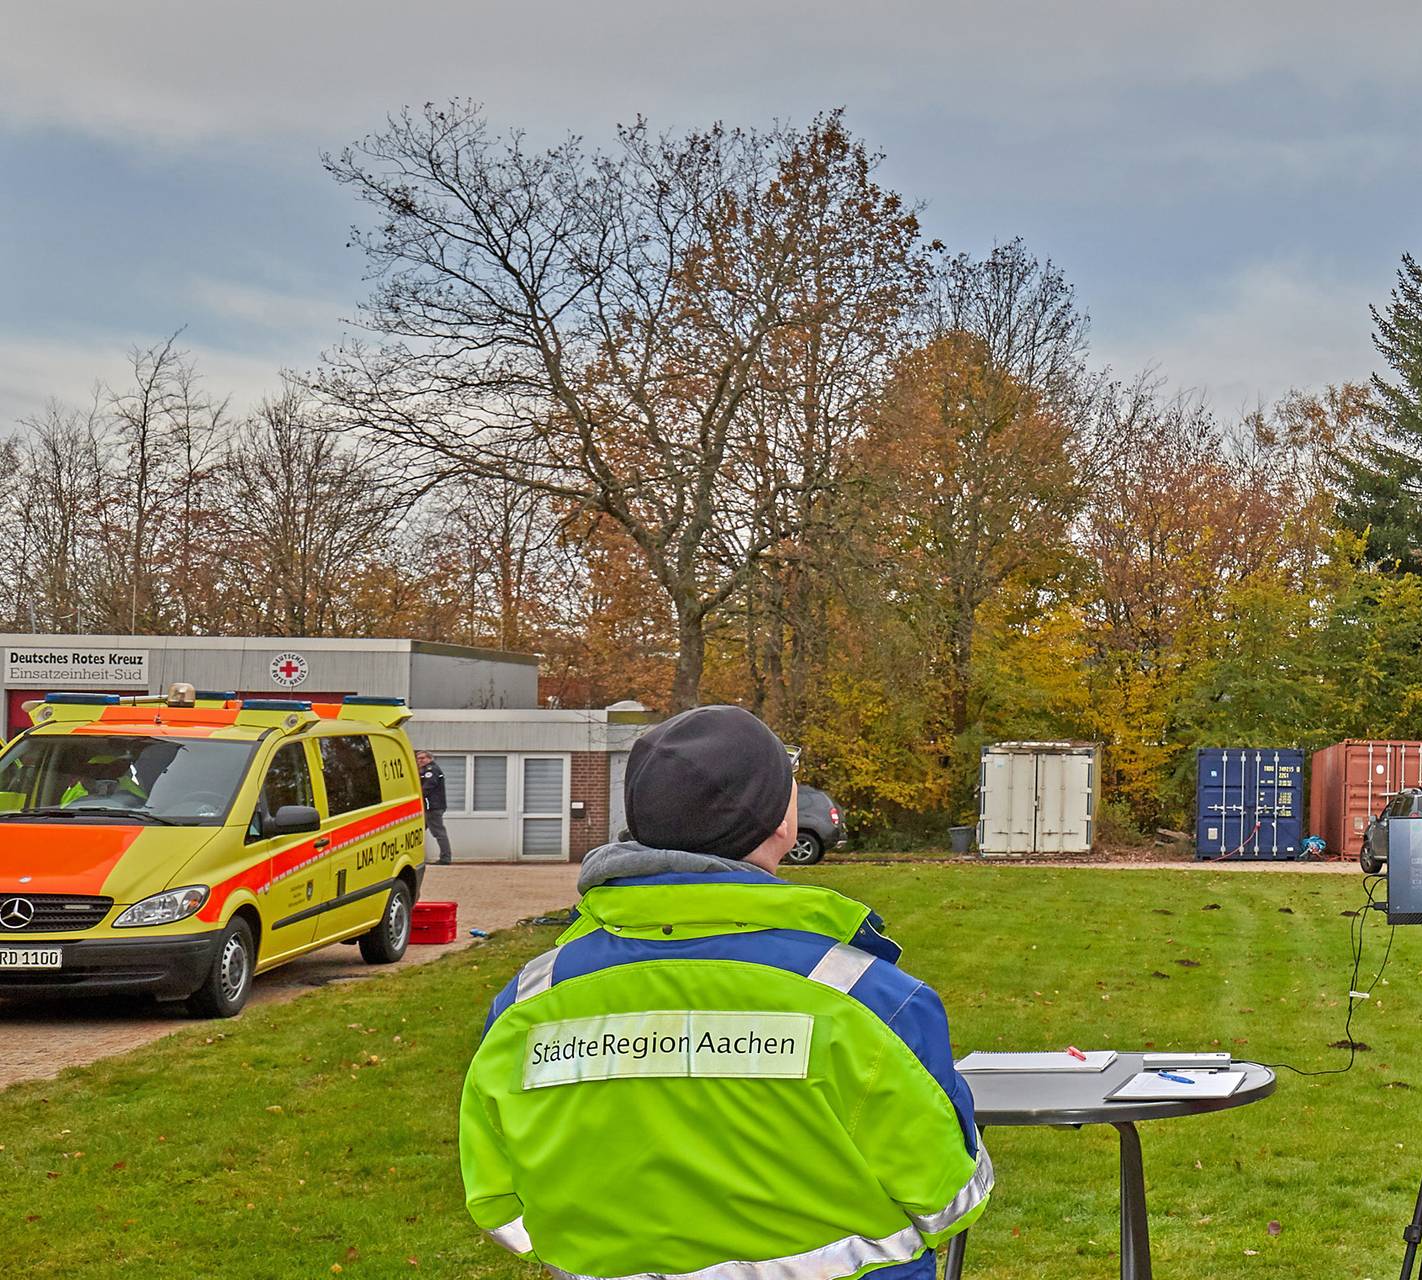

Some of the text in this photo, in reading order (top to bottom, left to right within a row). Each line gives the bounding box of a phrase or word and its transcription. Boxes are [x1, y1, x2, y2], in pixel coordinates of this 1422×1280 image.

[10, 652, 143, 665] Deutsches Rotes Kreuz
[9, 667, 142, 680] Einsatzeinheit-Süd
[389, 758, 404, 779] 112
[356, 847, 374, 871] LNA
[380, 837, 400, 861] OrgL
[405, 827, 423, 850] NORD
[0, 951, 58, 965] RD 1100
[531, 1031, 796, 1065] StädteRegion Aachen
